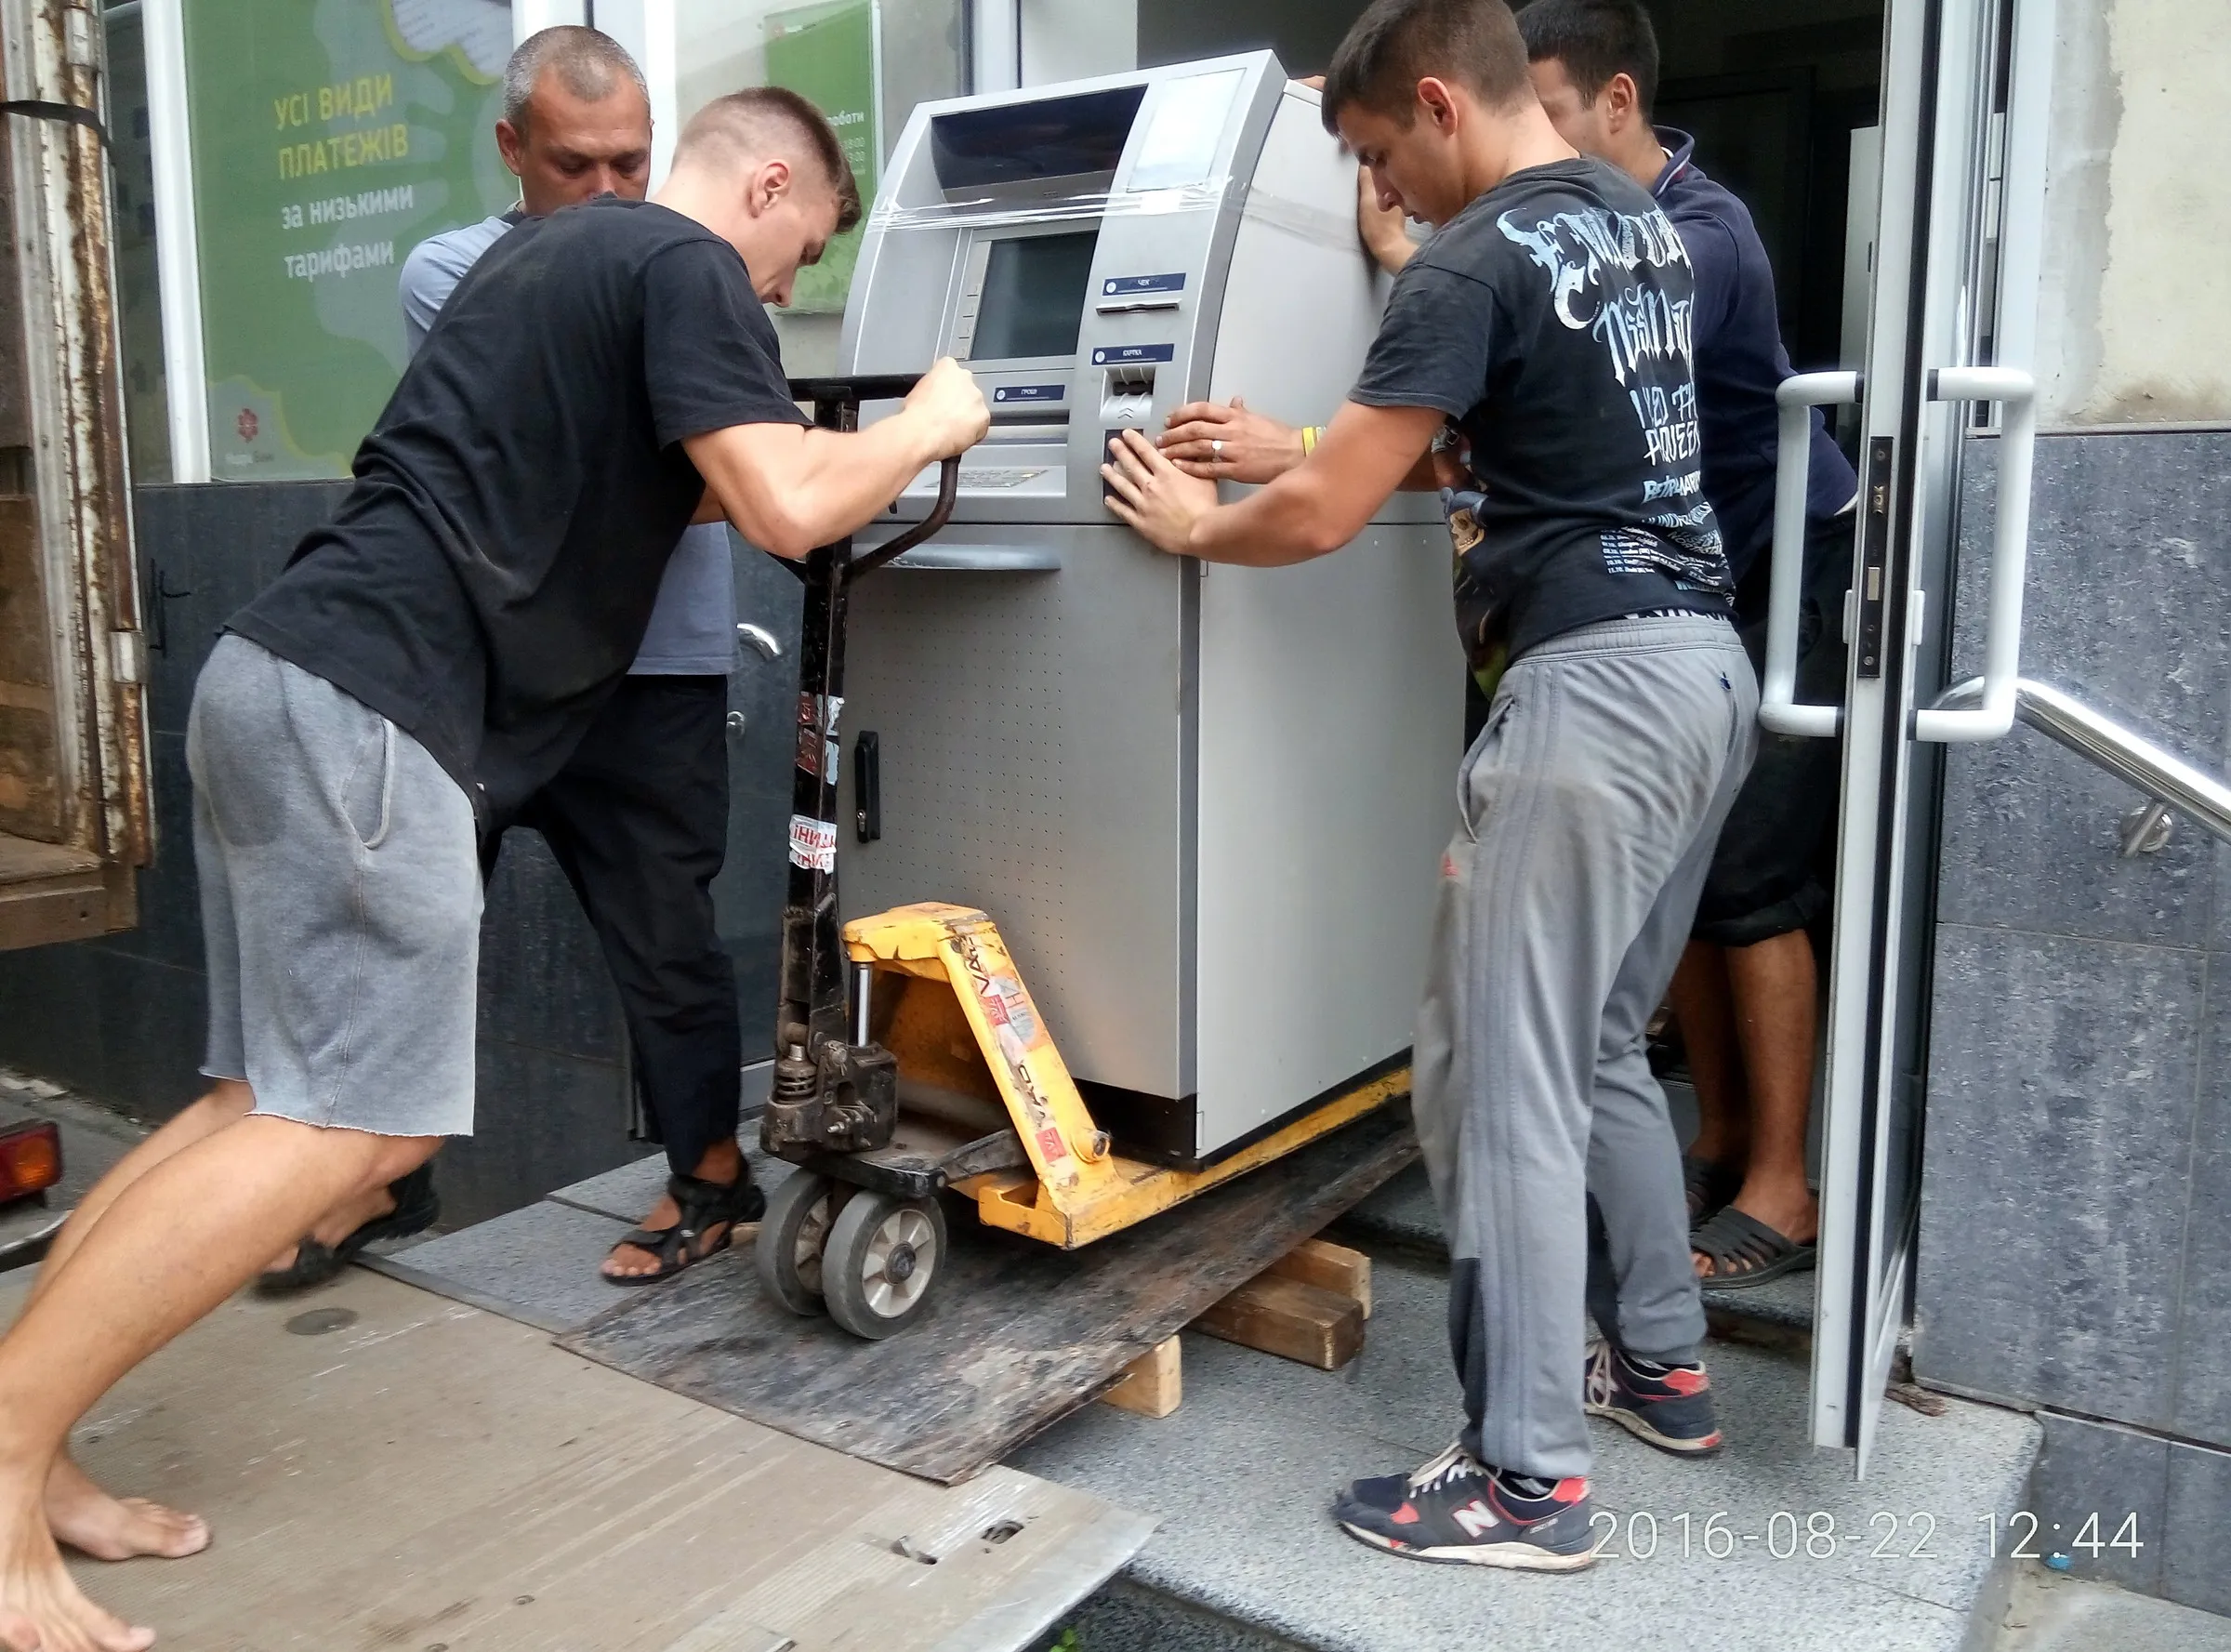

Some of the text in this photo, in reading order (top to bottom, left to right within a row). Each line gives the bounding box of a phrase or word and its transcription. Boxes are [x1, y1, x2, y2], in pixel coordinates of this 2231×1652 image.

[273, 73, 392, 131] УСІ ВИДИ
[280, 123, 408, 179] ПЛАТЕЖІВ
[282, 185, 414, 230] за низькими
[284, 241, 394, 283] тарифами
